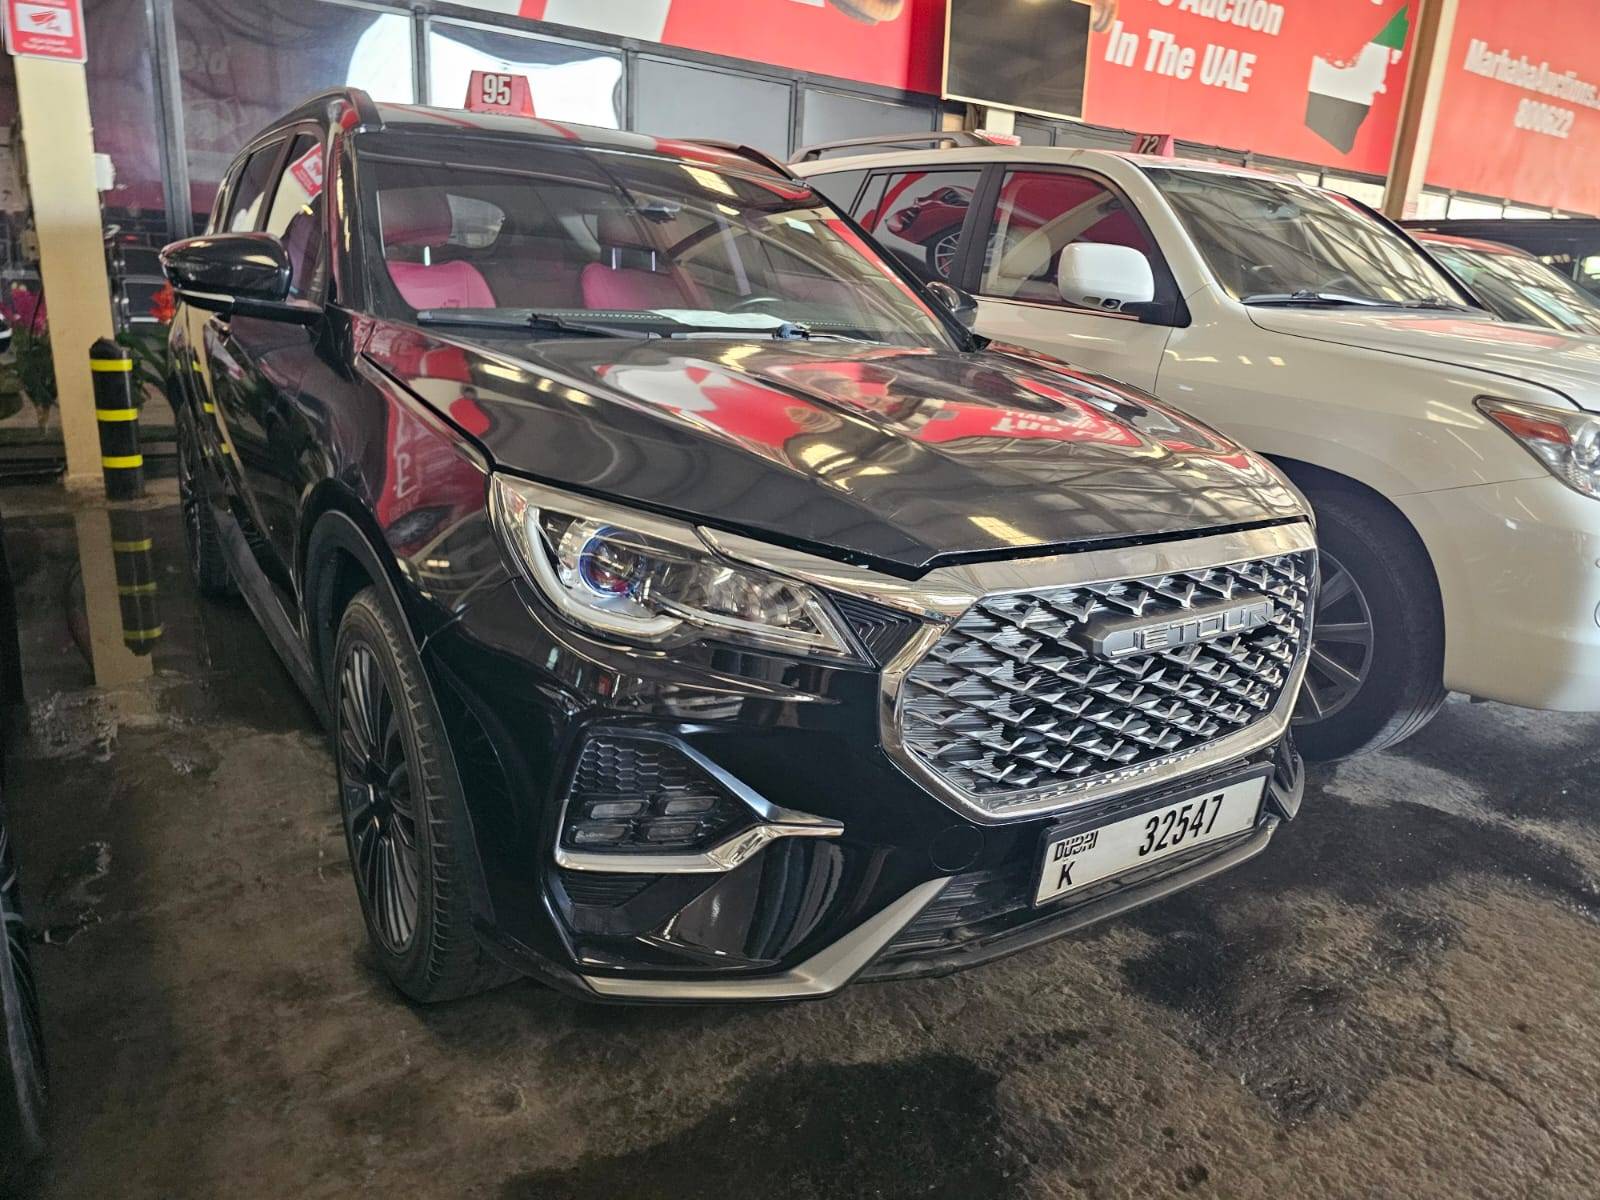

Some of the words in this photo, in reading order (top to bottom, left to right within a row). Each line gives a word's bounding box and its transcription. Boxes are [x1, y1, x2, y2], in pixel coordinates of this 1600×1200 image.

[1104, 20, 1139, 67] In
[1144, 28, 1196, 80] The
[1200, 43, 1257, 93] UAE
[482, 74, 511, 106] 95
[1138, 135, 1160, 155] 72
[1110, 602, 1269, 657] JETOUR
[1138, 793, 1225, 857] 32547
[1056, 861, 1075, 890] K
